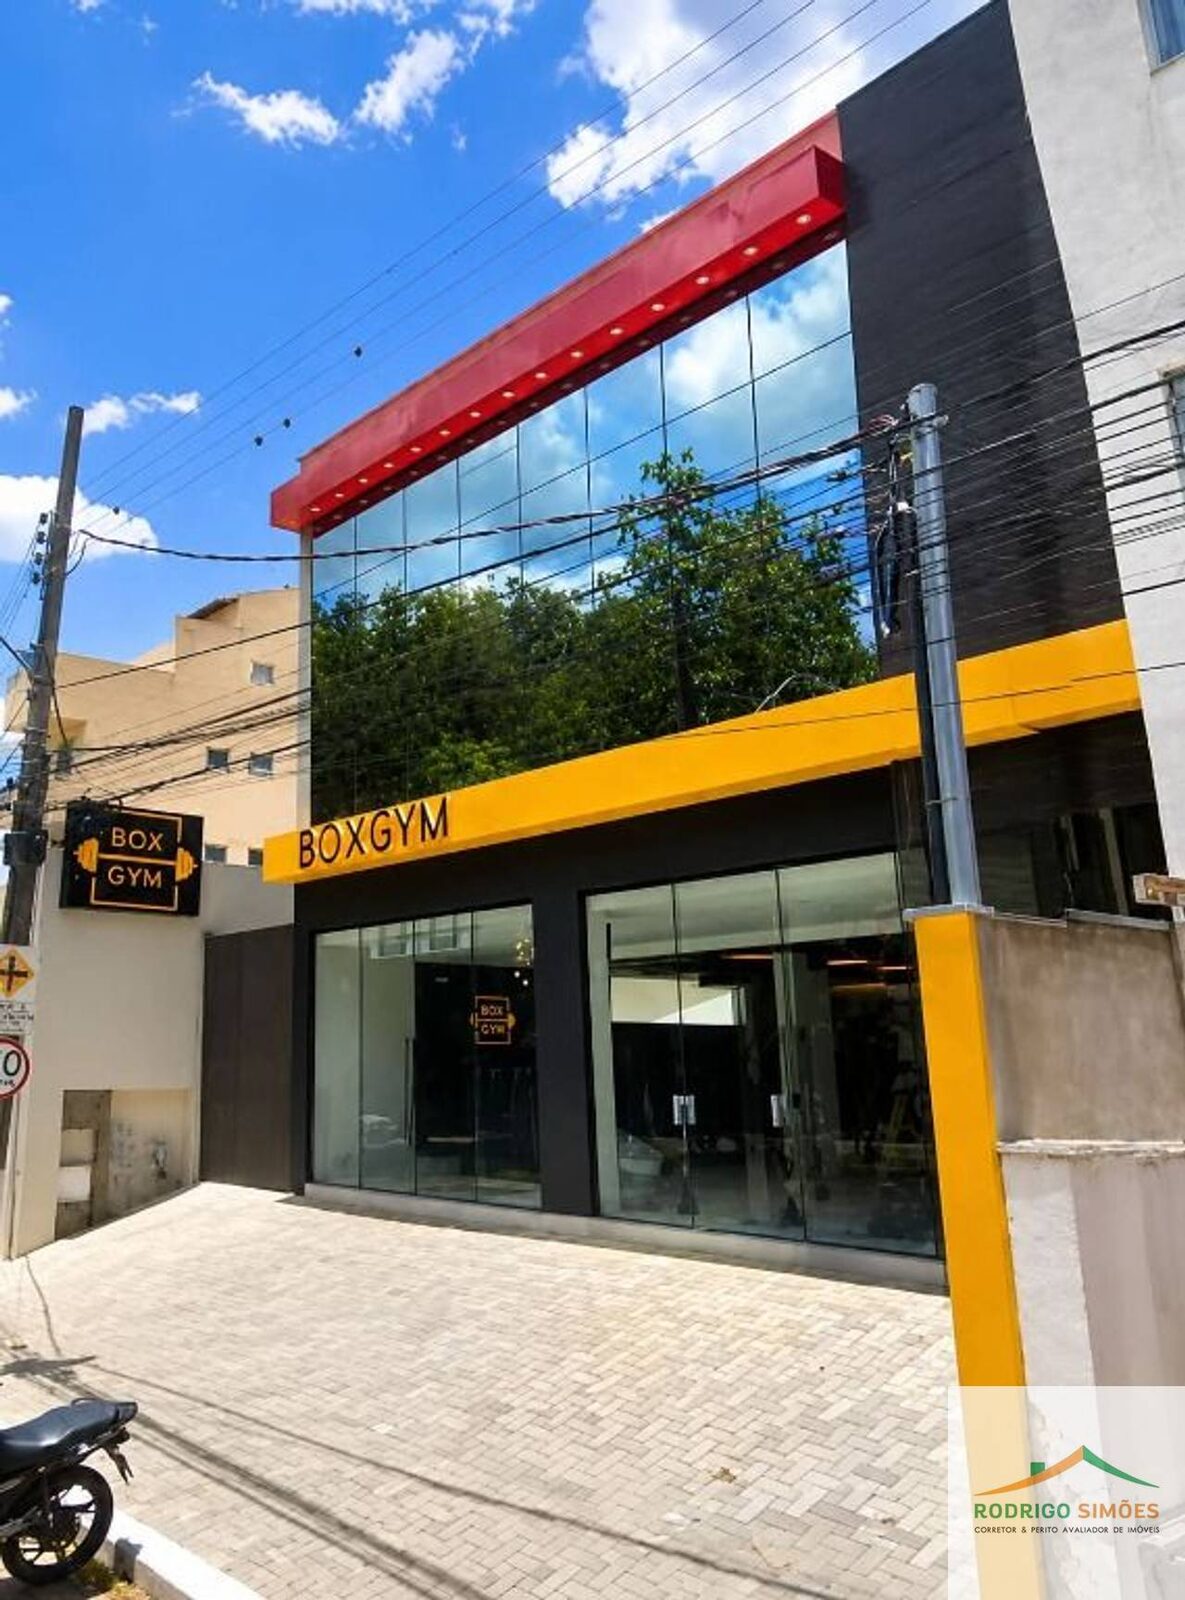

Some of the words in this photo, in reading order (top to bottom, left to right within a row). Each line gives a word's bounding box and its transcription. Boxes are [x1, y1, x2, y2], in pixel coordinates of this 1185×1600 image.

[111, 827, 163, 851] BOX
[300, 797, 449, 869] BOXGYM
[107, 865, 162, 889] GYM
[481, 1005, 503, 1015] BOX
[0, 1050, 21, 1077] 0
